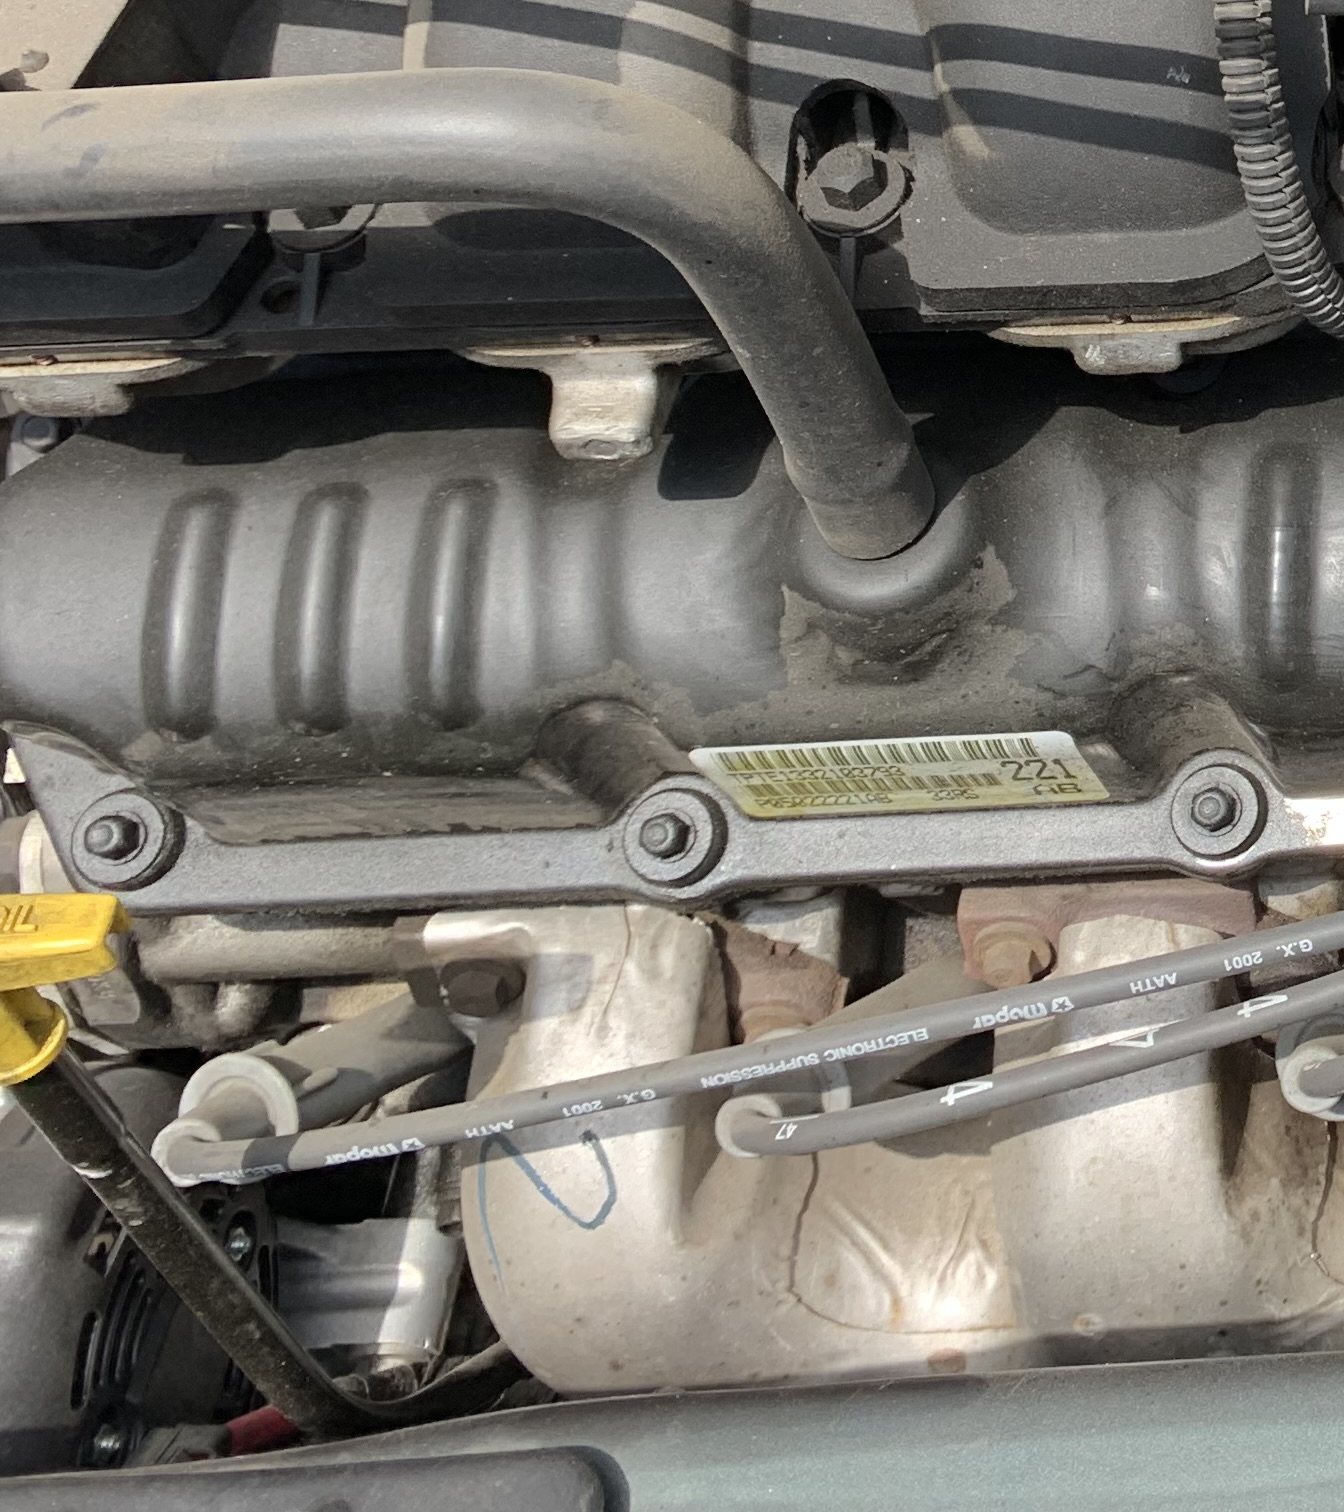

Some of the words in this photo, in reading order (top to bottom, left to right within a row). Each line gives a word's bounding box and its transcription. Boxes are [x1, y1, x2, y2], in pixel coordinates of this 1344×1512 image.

[1000, 759, 1078, 781] 221
[1275, 938, 1313, 959] G.X.
[1223, 950, 1264, 972] 2001
[1129, 971, 1178, 995] AATH
[824, 1027, 929, 1063] ELECTRONIC
[701, 1052, 820, 1089] SUPPRESSION
[562, 1099, 604, 1119] 2001
[774, 1123, 799, 1141] 47
